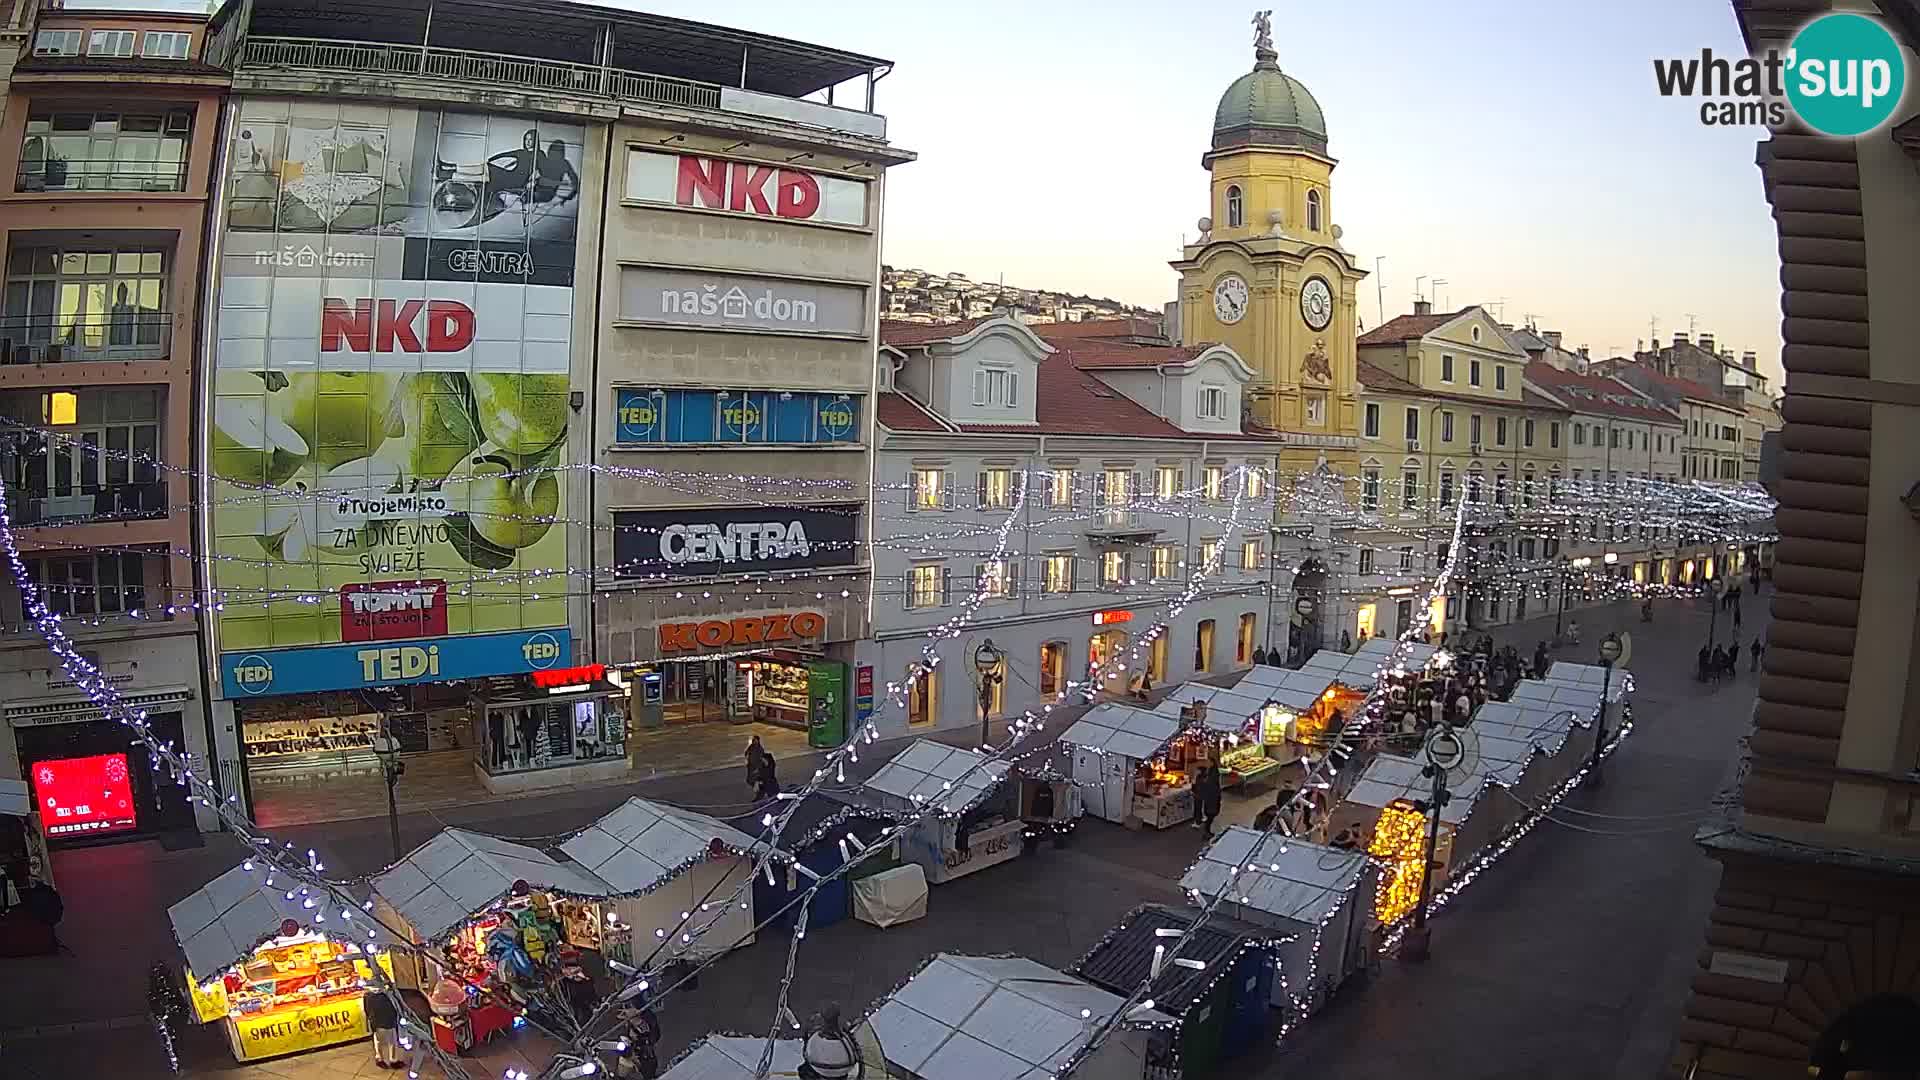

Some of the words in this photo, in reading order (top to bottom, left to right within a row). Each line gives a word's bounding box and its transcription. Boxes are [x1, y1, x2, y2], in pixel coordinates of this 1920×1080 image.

[676, 155, 820, 219] NKD
[255, 244, 295, 267] naš
[318, 244, 367, 268] dom
[447, 249, 535, 275] CENTRA
[661, 283, 718, 316] naš
[754, 290, 817, 323] dom
[320, 297, 477, 353] NKD
[618, 407, 658, 425] TEDi
[723, 408, 760, 426] TEDi
[820, 410, 854, 427] TEDi
[338, 496, 446, 516] #TvojeMisto
[334, 528, 358, 549] ZA
[366, 523, 450, 549] DNEVNO
[659, 520, 811, 564] CENTRA
[359, 545, 426, 575] SVJEŽE
[349, 585, 438, 614] TOMMY
[659, 611, 826, 652] KORZO
[358, 645, 440, 682] TEDi
[522, 642, 560, 660] TEDi
[233, 664, 273, 684] TEDi
[250, 1021, 292, 1041] SWEET
